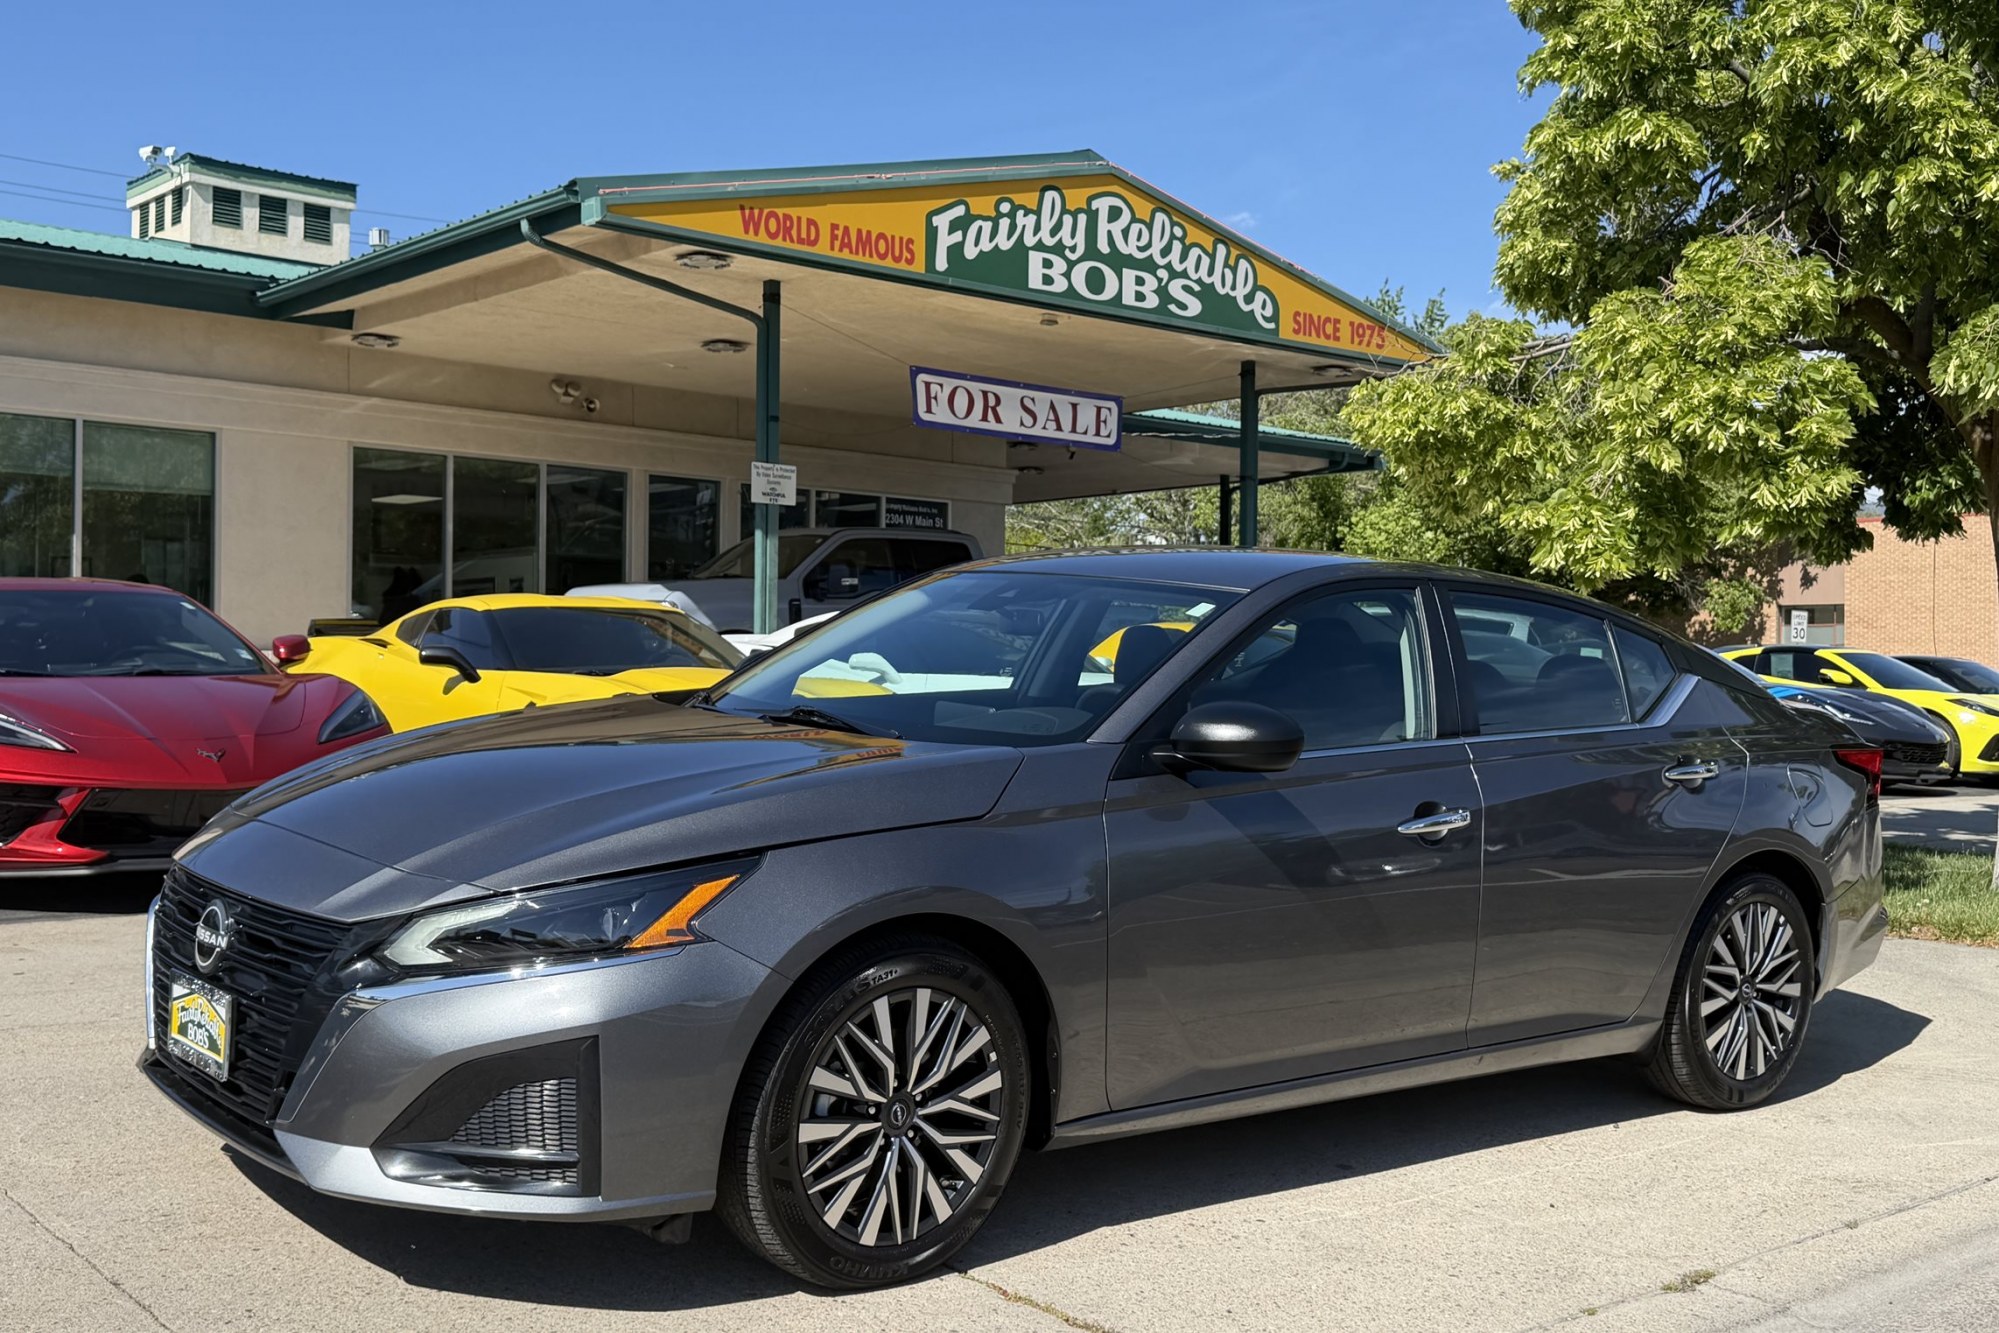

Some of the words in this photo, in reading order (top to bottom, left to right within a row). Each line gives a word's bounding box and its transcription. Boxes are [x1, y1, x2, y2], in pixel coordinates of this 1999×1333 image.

[739, 204, 820, 247] WORLD
[830, 222, 916, 266] FAMOUS
[932, 190, 1087, 272] Fairly
[1091, 196, 1276, 329] Reliable
[1028, 250, 1202, 317] BOB'S
[1292, 310, 1341, 342] SINCE
[1349, 321, 1386, 350] 1975
[921, 380, 1004, 424] FOR
[1019, 395, 1113, 438] SALE
[886, 513, 904, 524] 2304
[905, 514, 914, 526] W
[915, 515, 934, 527] Main
[934, 517, 944, 528] St
[1792, 627, 1805, 639] 30
[197, 926, 228, 949] SSAN
[187, 1022, 210, 1049] BOB'S
